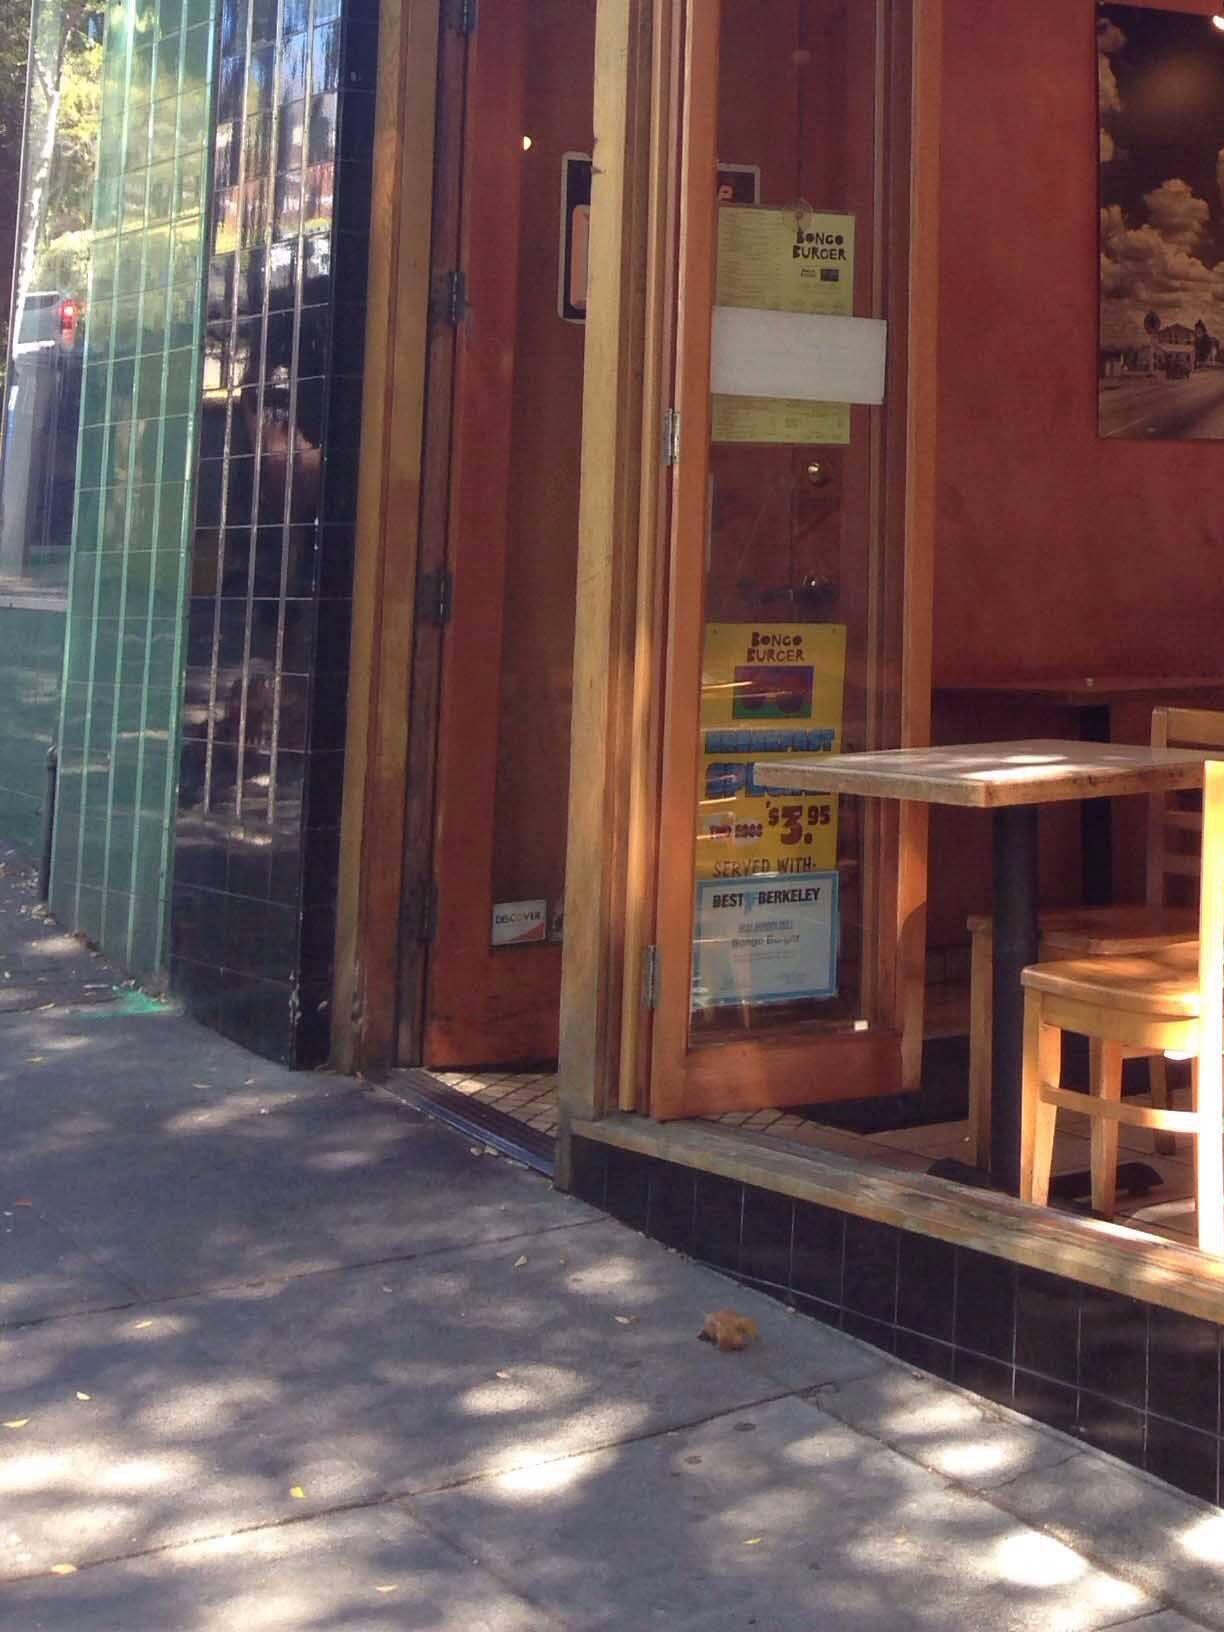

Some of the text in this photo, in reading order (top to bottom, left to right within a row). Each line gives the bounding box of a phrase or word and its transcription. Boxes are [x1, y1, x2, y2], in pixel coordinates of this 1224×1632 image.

[796, 230, 845, 246] BONGO
[792, 245, 847, 261] BURGER
[751, 631, 803, 647] BONGO
[747, 648, 805, 663] BURGER
[712, 893, 744, 909] BEST
[758, 887, 821, 905] BERKELEY
